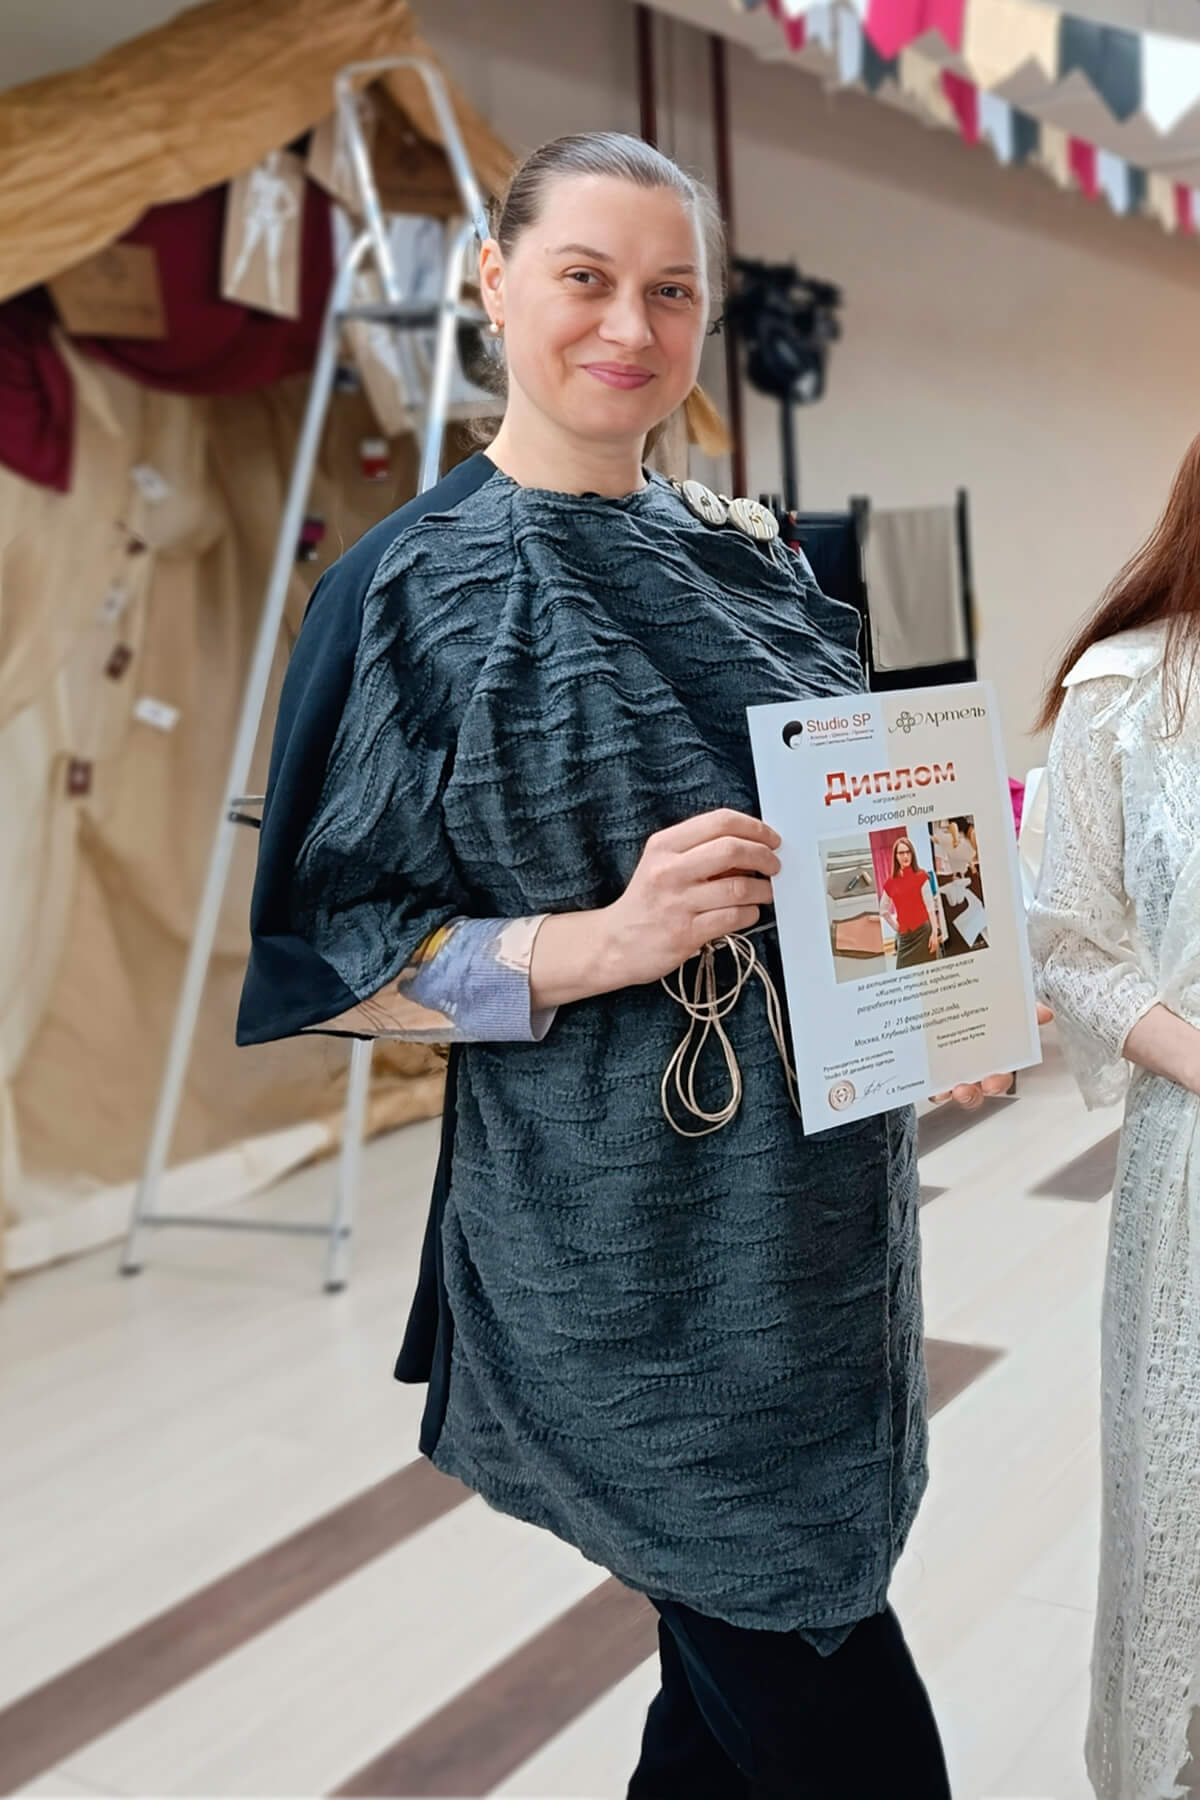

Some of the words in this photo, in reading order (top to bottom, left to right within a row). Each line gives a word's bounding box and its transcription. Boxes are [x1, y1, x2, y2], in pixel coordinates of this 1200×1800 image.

[806, 717, 849, 733] Studio
[852, 712, 871, 727] SP
[924, 706, 987, 727] Артель
[824, 761, 956, 807] Диплом
[858, 810, 905, 825] Борисова
[907, 804, 934, 816] Юлия
